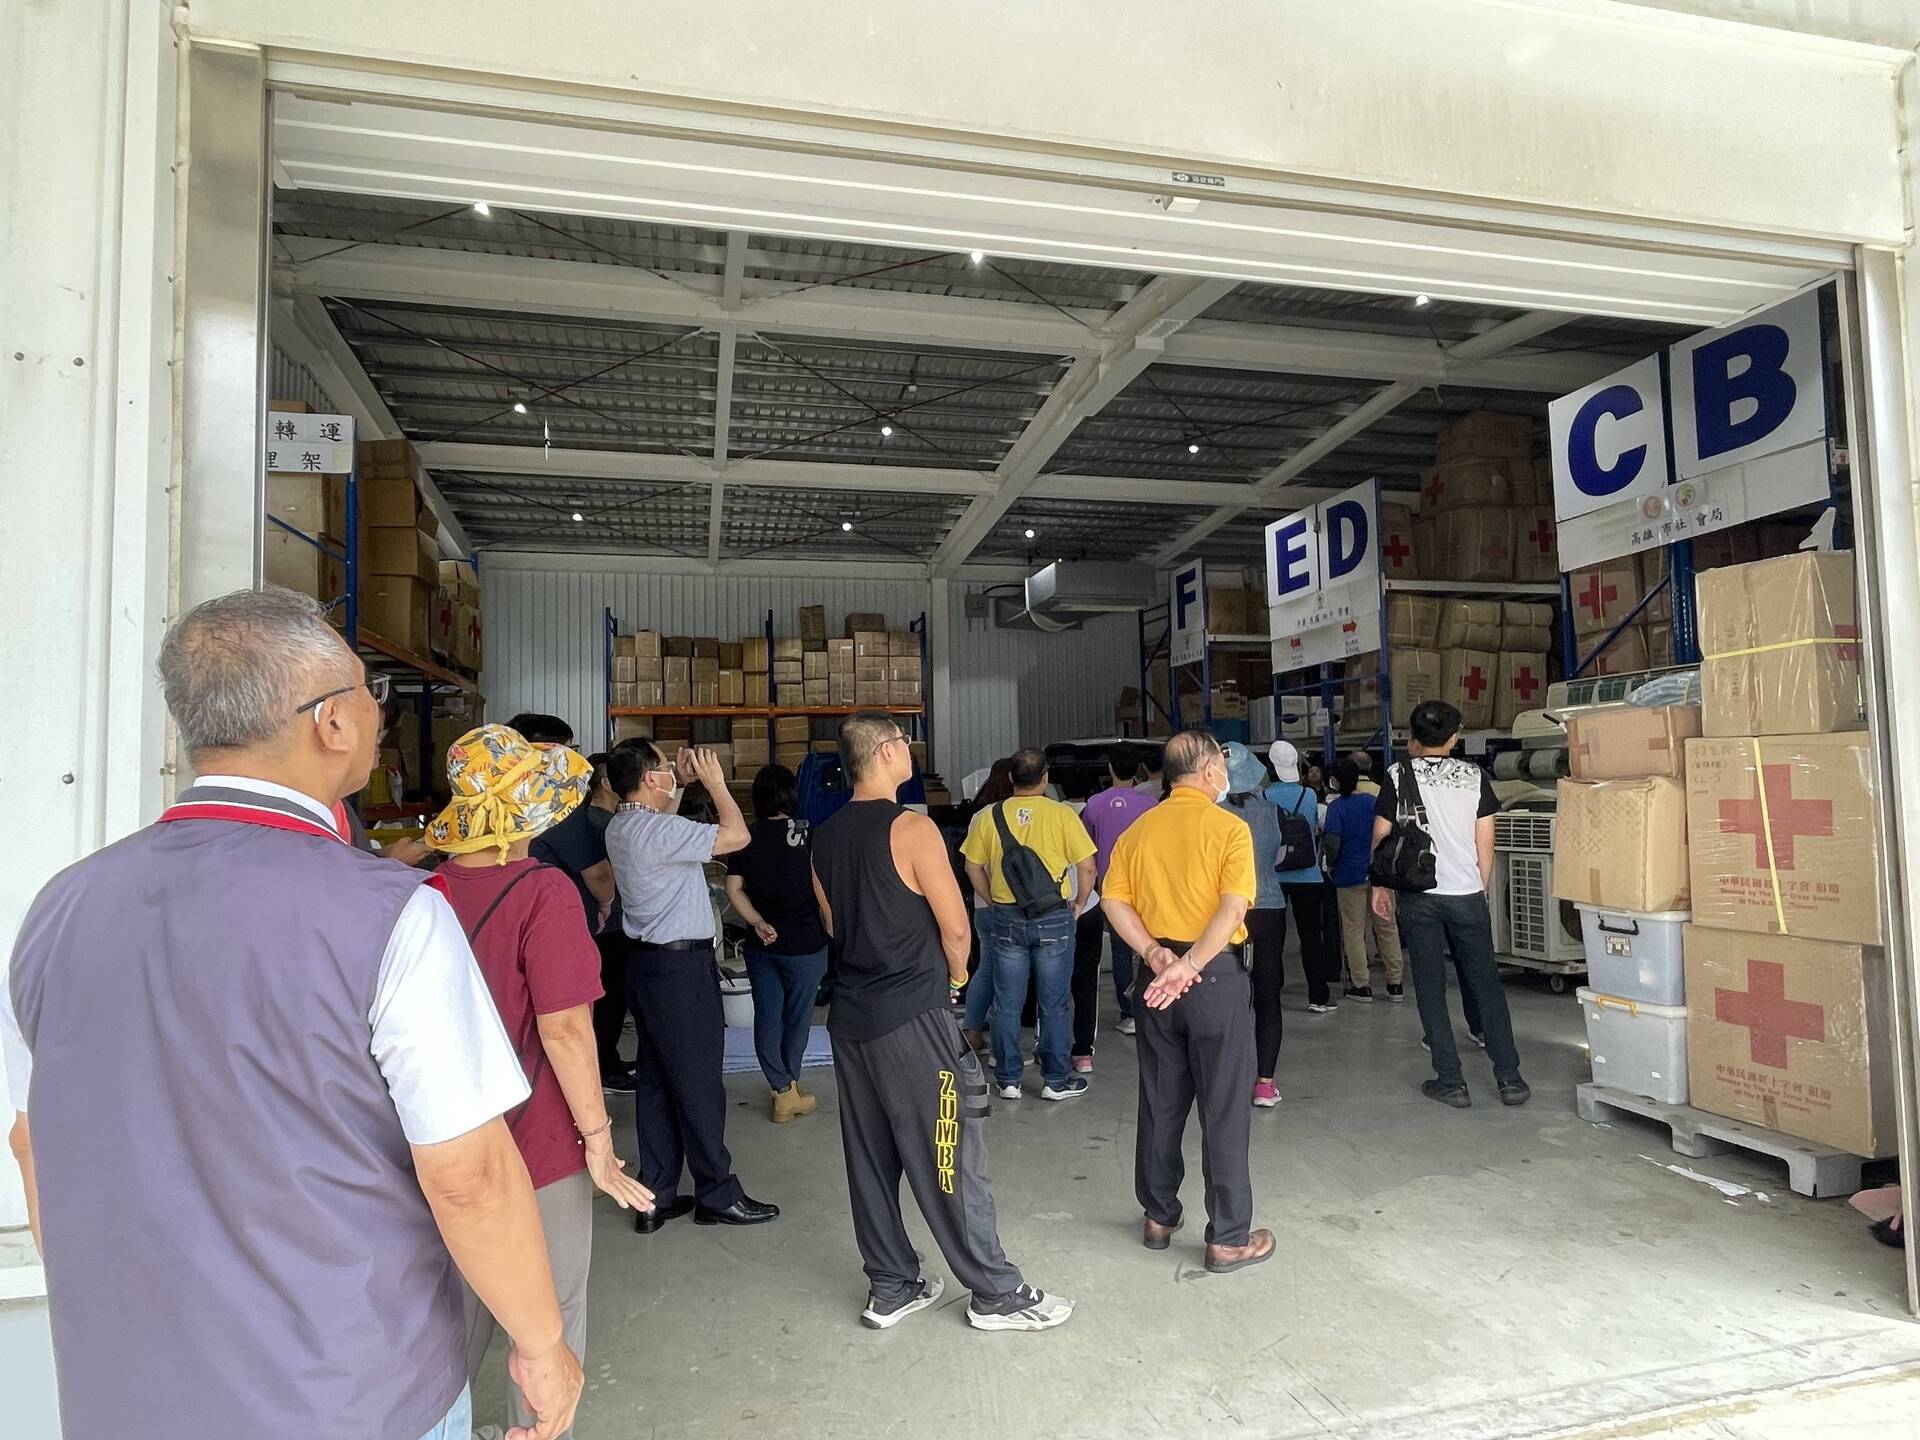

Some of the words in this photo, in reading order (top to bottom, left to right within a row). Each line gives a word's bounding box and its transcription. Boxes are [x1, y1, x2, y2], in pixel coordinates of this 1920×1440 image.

[1692, 324, 1797, 460] B
[274, 419, 342, 441] 轉運
[1568, 384, 1647, 496] C
[1275, 517, 1310, 596] E
[1326, 500, 1368, 580] D
[1631, 507, 1723, 546] 高雄市社會局
[1176, 567, 1196, 630] F
[1720, 876, 1808, 892] 中華民國紅字會
